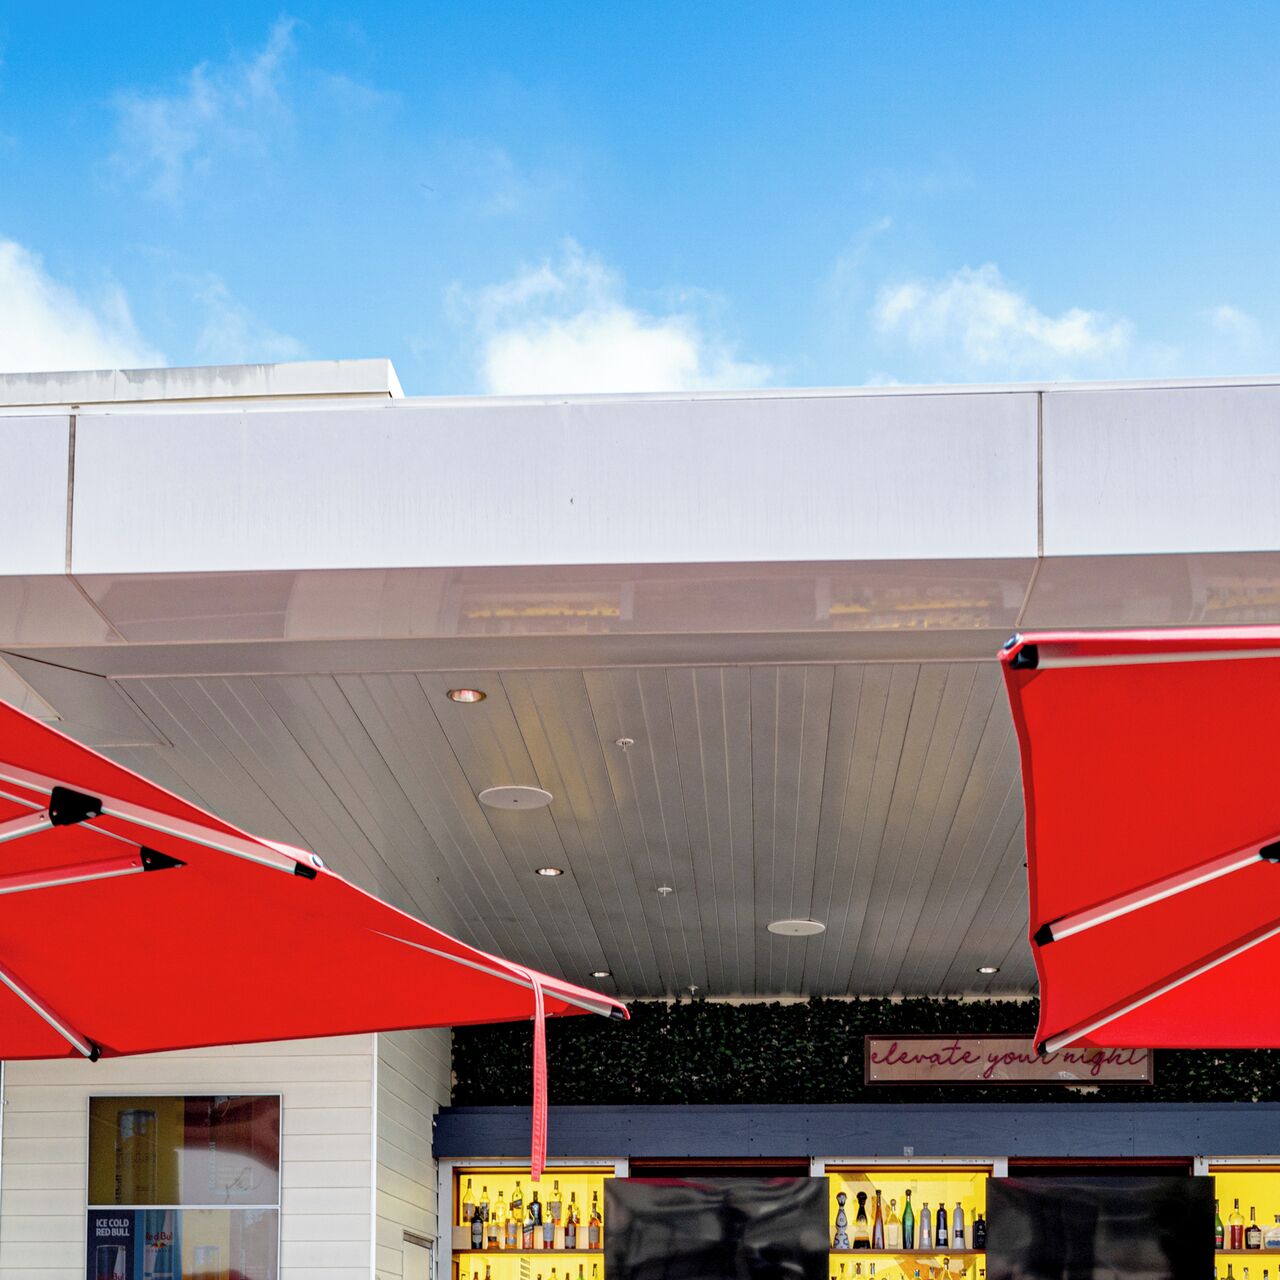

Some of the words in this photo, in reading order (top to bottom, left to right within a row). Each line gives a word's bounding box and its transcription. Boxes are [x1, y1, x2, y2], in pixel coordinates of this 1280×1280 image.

[871, 1040, 981, 1065] elevate
[95, 1218, 108, 1227] ICE
[108, 1218, 130, 1227] COLD
[95, 1227, 111, 1236] RED
[111, 1227, 130, 1236] BULL
